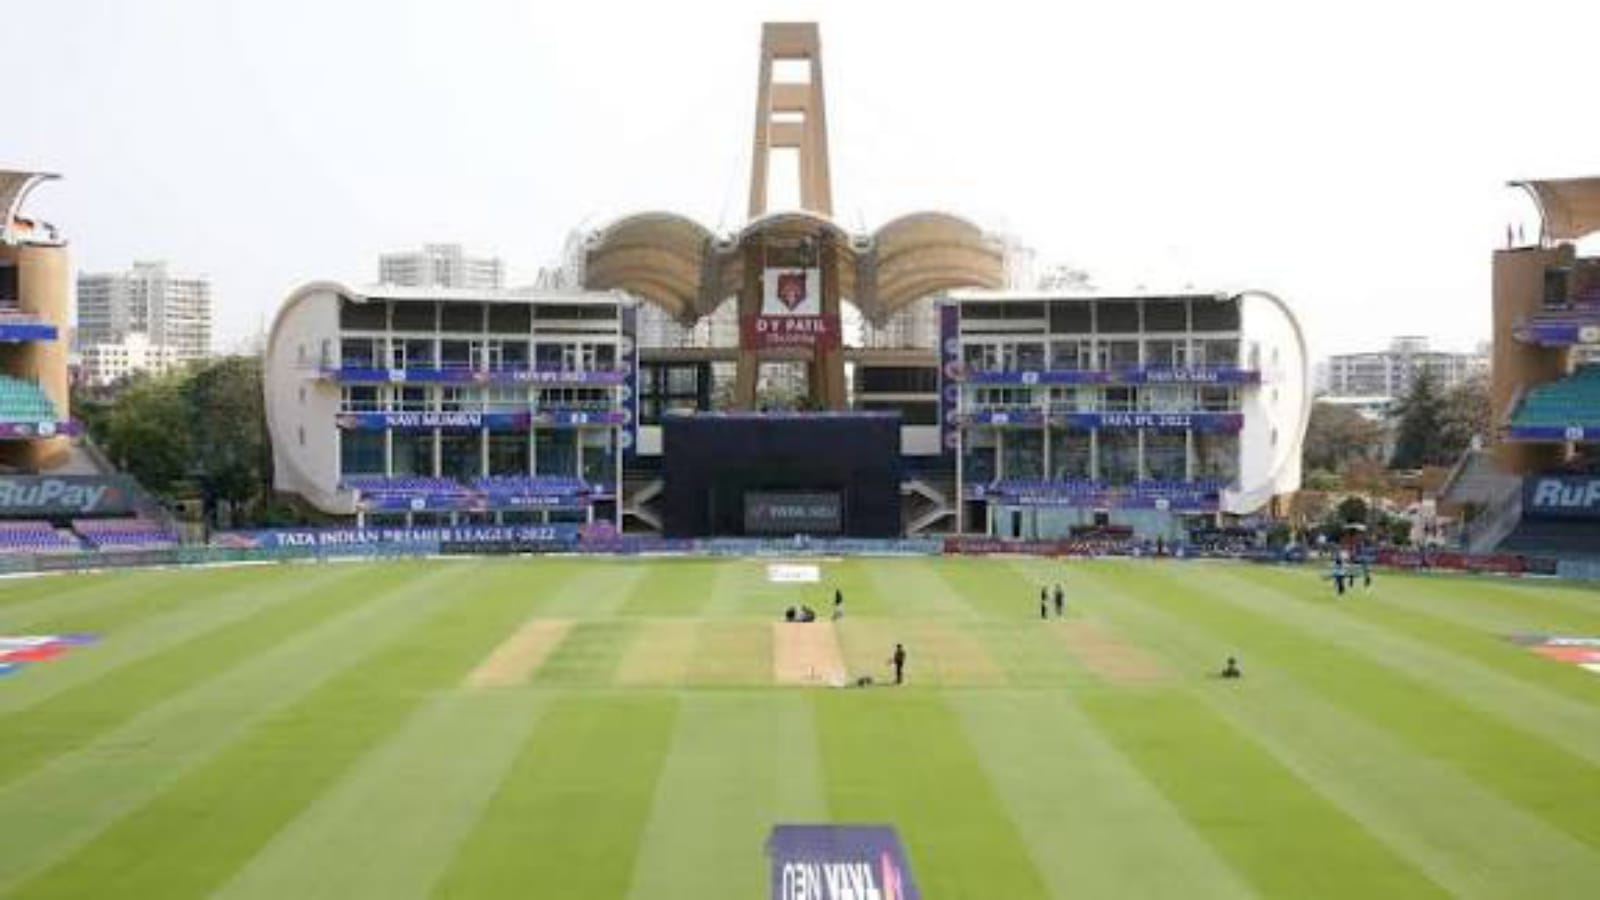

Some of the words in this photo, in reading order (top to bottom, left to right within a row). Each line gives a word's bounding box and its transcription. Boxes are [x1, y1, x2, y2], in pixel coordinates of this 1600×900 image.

[757, 319, 768, 332] D
[771, 319, 780, 332] Y
[785, 319, 826, 333] PATIL
[385, 413, 420, 427] NAVI
[422, 413, 482, 427] MUMBAI
[1101, 414, 1132, 426] TATA
[1135, 414, 1155, 427] IPL
[1158, 414, 1192, 427] 2022
[276, 532, 315, 546] TATA
[319, 531, 379, 544] INDIAN
[383, 530, 451, 543] PREMIER
[455, 529, 513, 541] LEAGUE
